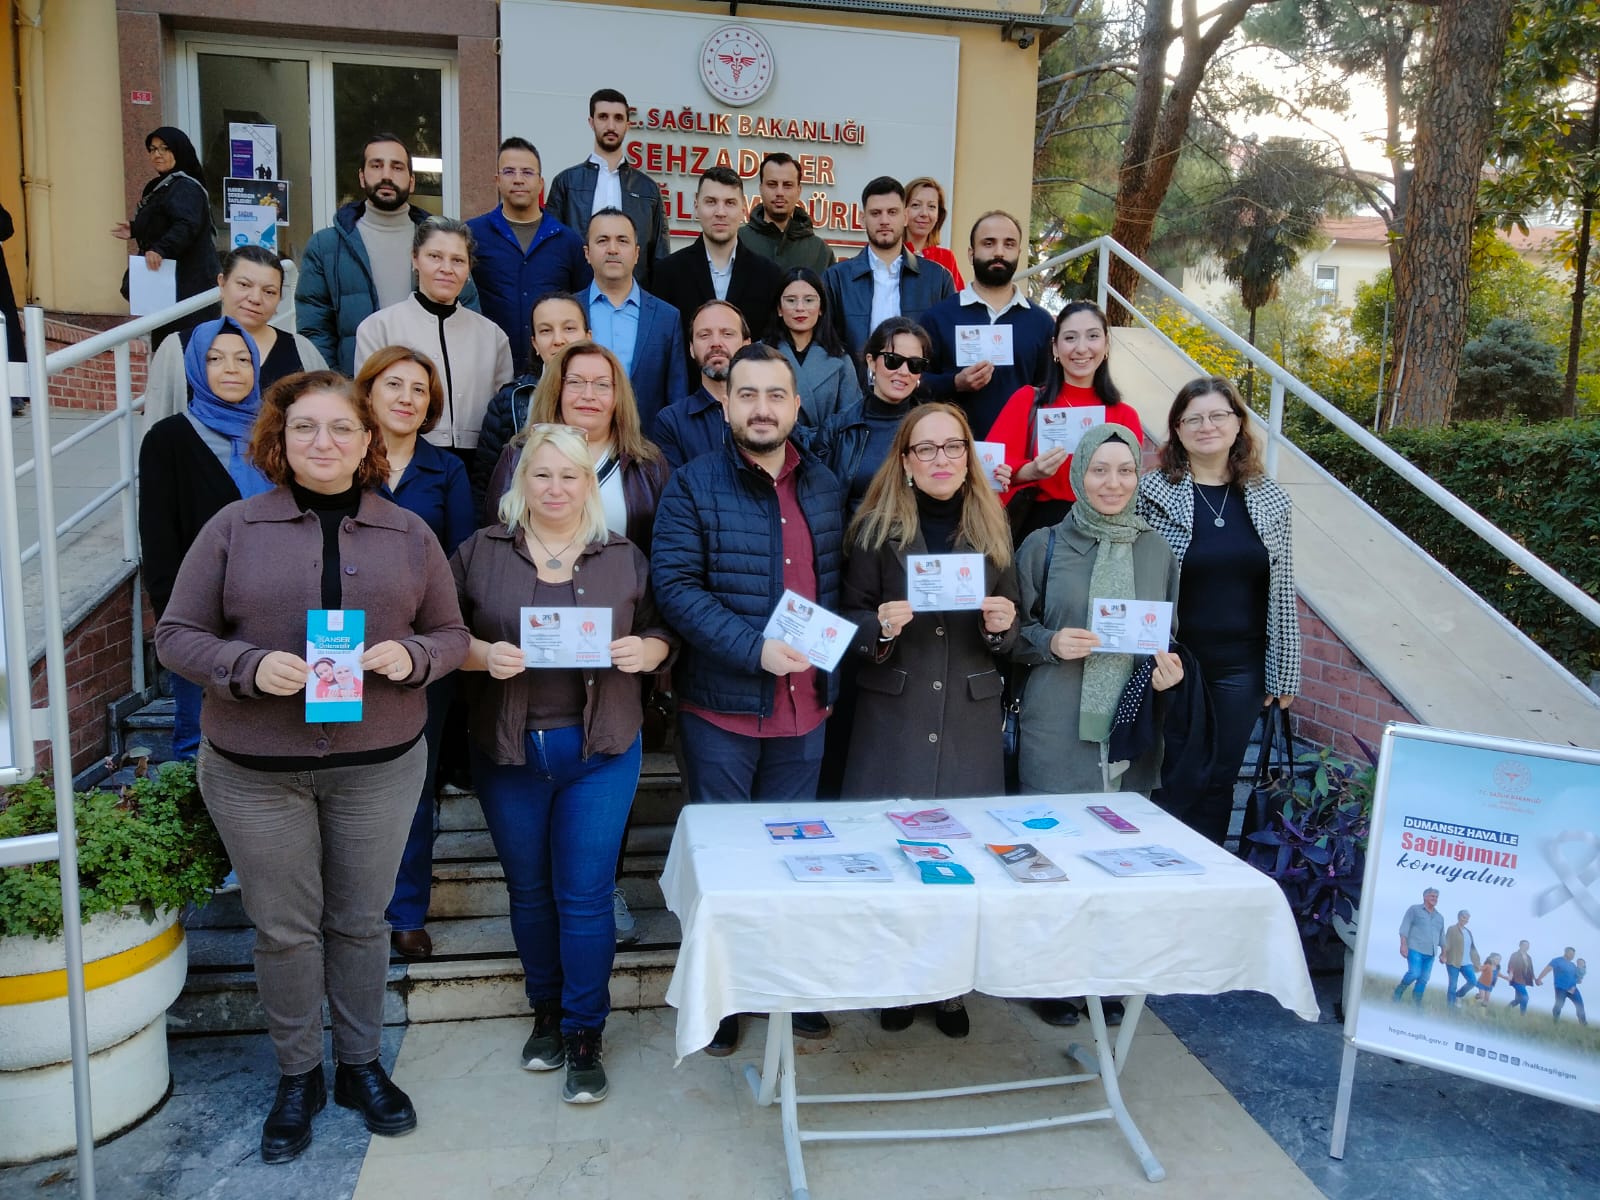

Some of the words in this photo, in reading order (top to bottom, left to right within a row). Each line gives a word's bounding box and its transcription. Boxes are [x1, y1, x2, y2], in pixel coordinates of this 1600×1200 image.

[647, 105, 732, 135] SAĞLIK
[737, 114, 866, 145] BAKANLIĞI
[1405, 817, 1465, 837] DUMANSIZ
[1466, 827, 1498, 842] HAVA
[1499, 832, 1519, 846] İLE
[1401, 831, 1518, 870] Sağlığımızı
[1396, 852, 1516, 888] koruyalım
